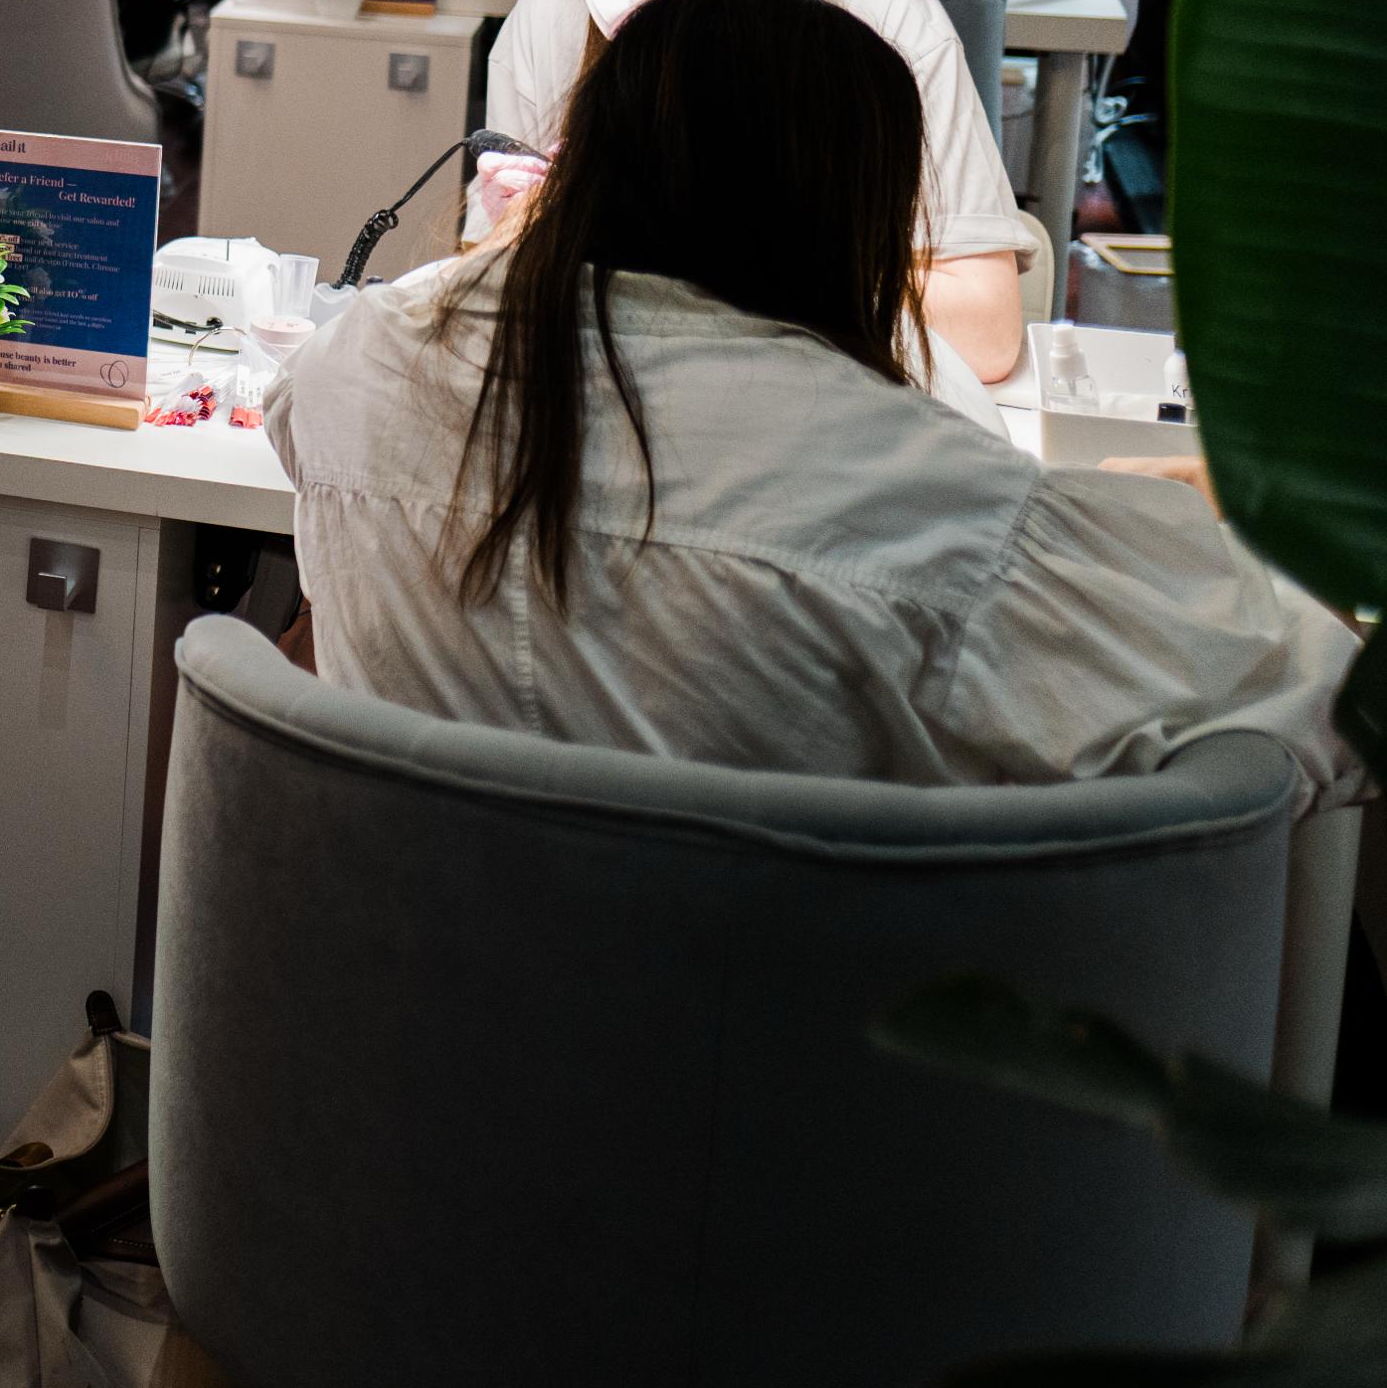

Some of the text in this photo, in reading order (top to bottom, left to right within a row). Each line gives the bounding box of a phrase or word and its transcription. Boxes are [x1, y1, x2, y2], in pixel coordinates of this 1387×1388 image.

[18, 143, 27, 153] it
[20, 175, 27, 184] a
[29, 175, 64, 188] Friend
[59, 191, 135, 208] Get Rewarded!
[26, 210, 48, 219] friend
[87, 217, 105, 225] salon
[106, 219, 120, 227] and
[8, 235, 19, 243] off
[74, 252, 108, 262] treatment
[67, 289, 87, 300] 10%
[15, 351, 41, 364] beauty
[43, 355, 51, 364] is
[52, 357, 77, 367] better
[4, 361, 32, 372] shared
